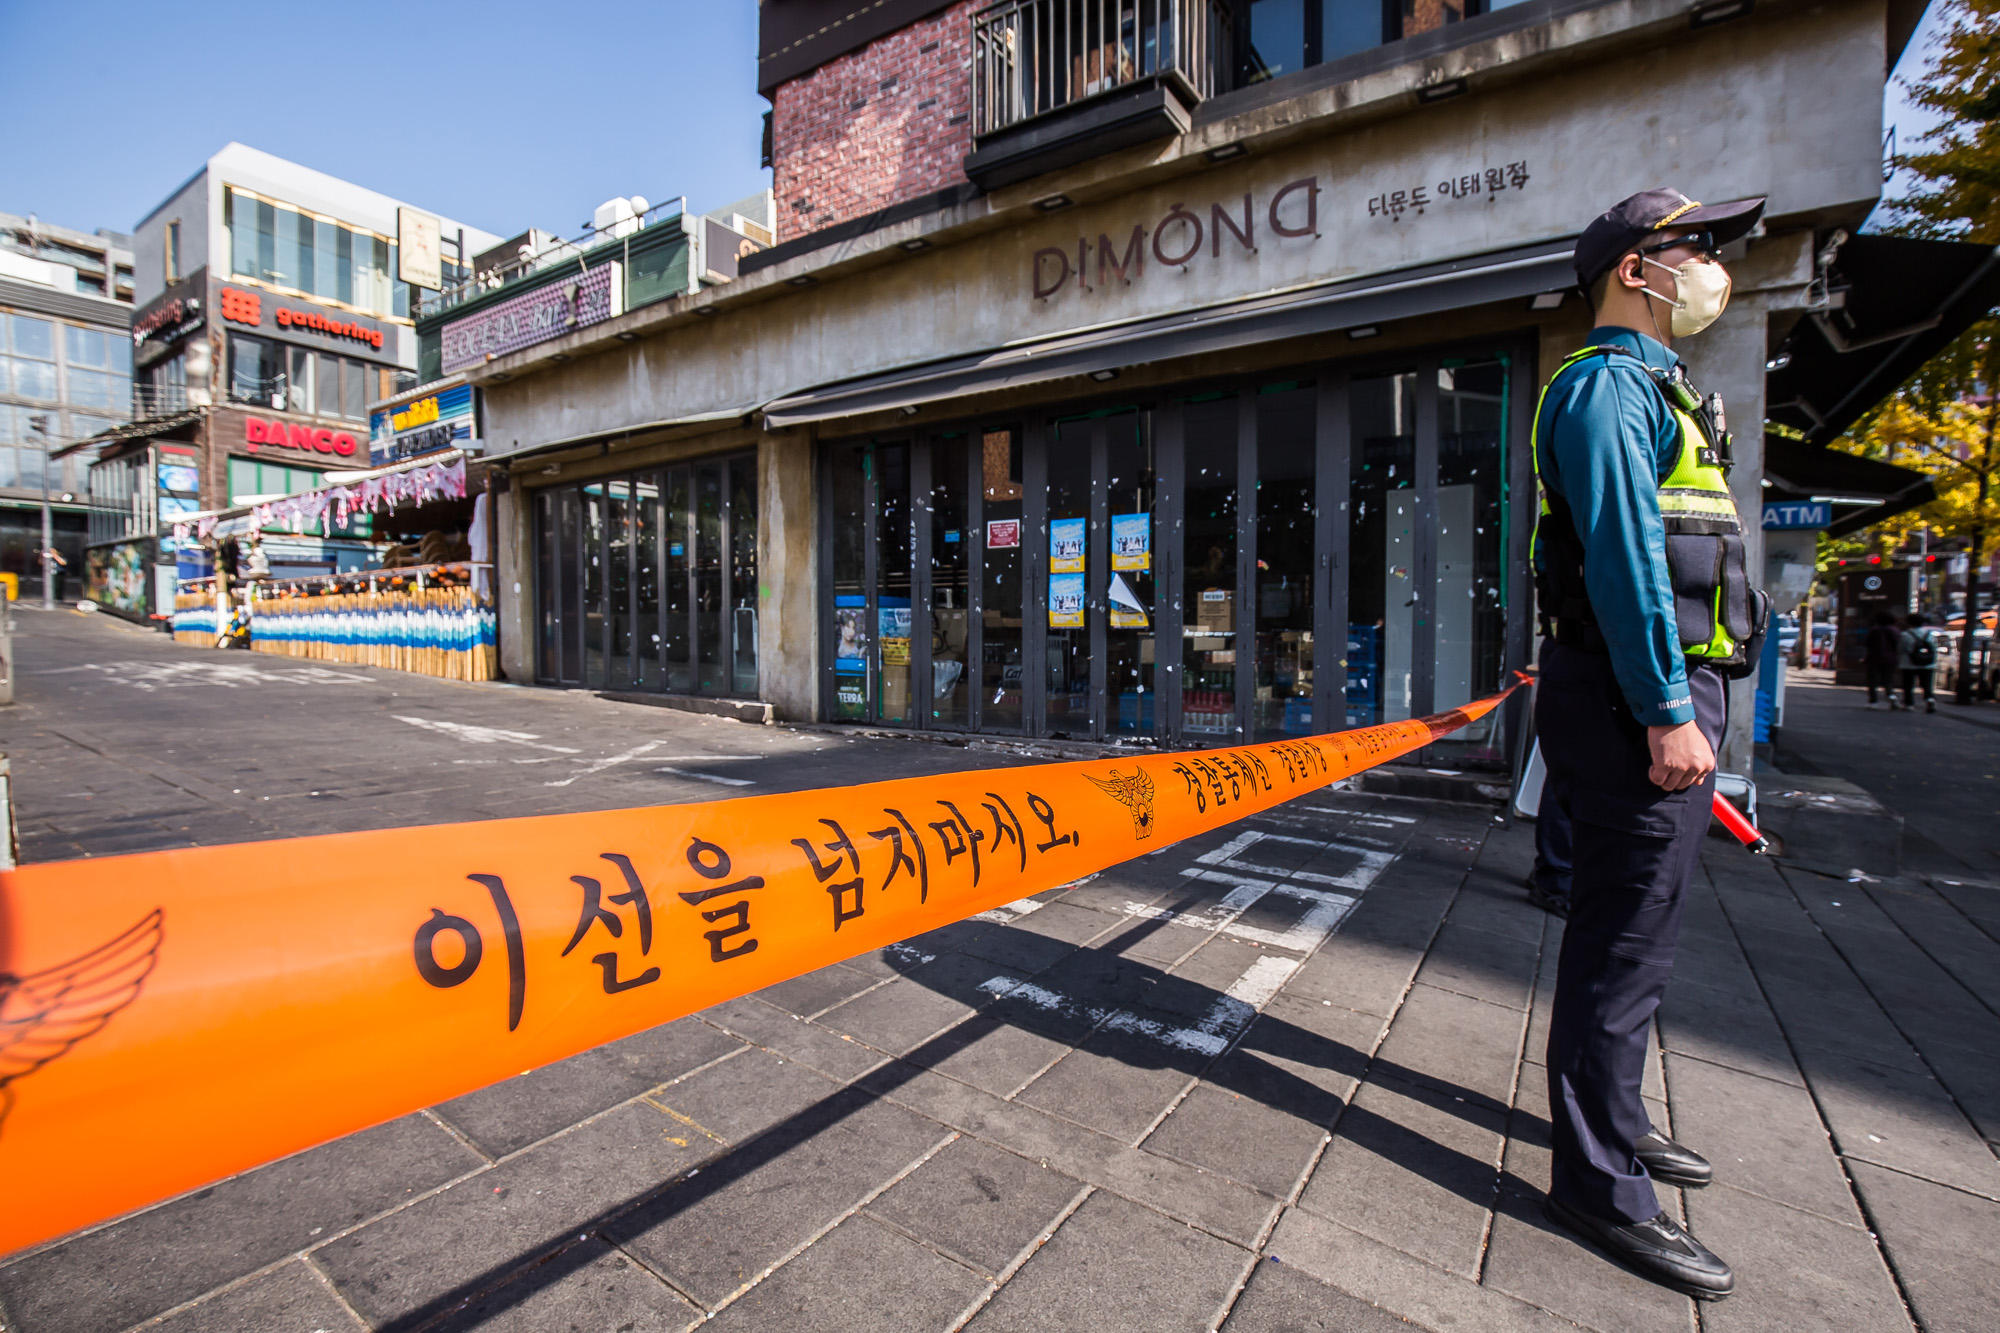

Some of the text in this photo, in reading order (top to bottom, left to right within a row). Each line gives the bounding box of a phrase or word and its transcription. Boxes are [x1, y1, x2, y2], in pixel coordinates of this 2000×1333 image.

[1437, 160, 1530, 199] 이태원점
[1033, 176, 1317, 299] DIMOND
[276, 307, 384, 347] gathering
[246, 416, 357, 456] DANCO
[1762, 505, 1824, 525] ATM
[838, 692, 863, 704] TERRA
[1172, 740, 1327, 813] 경찰통제선 경찰서장
